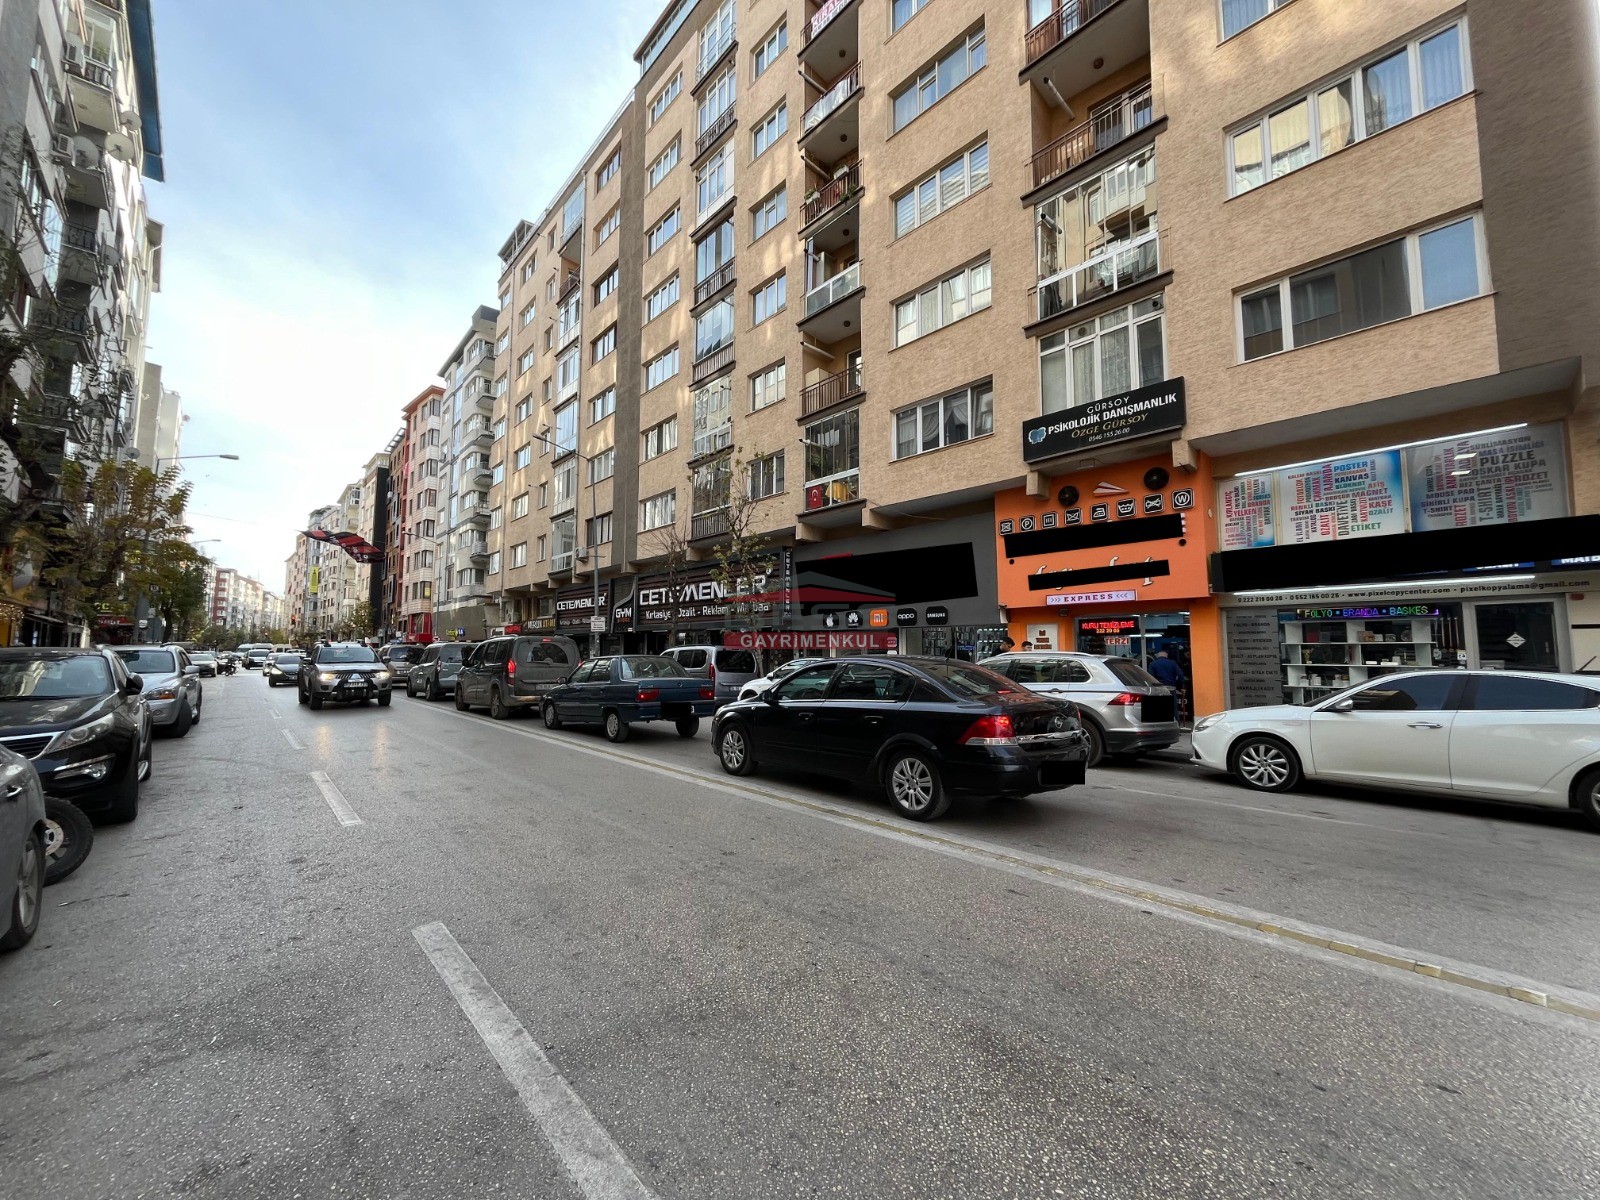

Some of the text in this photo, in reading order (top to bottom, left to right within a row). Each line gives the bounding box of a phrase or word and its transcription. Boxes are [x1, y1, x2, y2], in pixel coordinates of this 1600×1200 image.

[1087, 396, 1130, 414] GÜRSOY
[1048, 393, 1177, 434] PSİKOLOJİK DANIŞMANLIK
[1071, 413, 1148, 438] ÖZGE GÜRSOY
[1479, 448, 1504, 456] MASA
[1480, 450, 1535, 466] PUZZLE
[1334, 461, 1368, 472] POSTER
[1472, 464, 1509, 476] OSKAR
[1514, 459, 1546, 470] KUPA
[1322, 464, 1333, 491] AJANDA
[1335, 473, 1369, 483] KANVAS
[1476, 478, 1502, 486] ÇANTA
[1514, 472, 1548, 482] ROZET
[1352, 488, 1388, 498] MAGNET
[1368, 500, 1392, 509] KAŞE
[1452, 496, 1475, 504] KUPA
[1477, 487, 1494, 522] T-SHIRT
[1234, 508, 1256, 517] YELKEN
[1316, 506, 1335, 514] BASKI
[1424, 506, 1452, 514] T-SHIRT
[1454, 504, 1467, 526] ROZET
[1336, 500, 1349, 536] DAVETİYE
[640, 575, 766, 605] CETMENLER
[1348, 588, 1450, 598] www.pixelcopycenter.com
[1460, 580, 1590, 593] pixelkopyalama@gmail.com
[557, 596, 605, 610] CETEMENLR
[1064, 593, 1113, 602] EXPRESS
[616, 608, 632, 618] GYM
[702, 606, 728, 616] Reklam
[1304, 609, 1332, 618] FOLYO
[1390, 606, 1429, 616] BASKES
